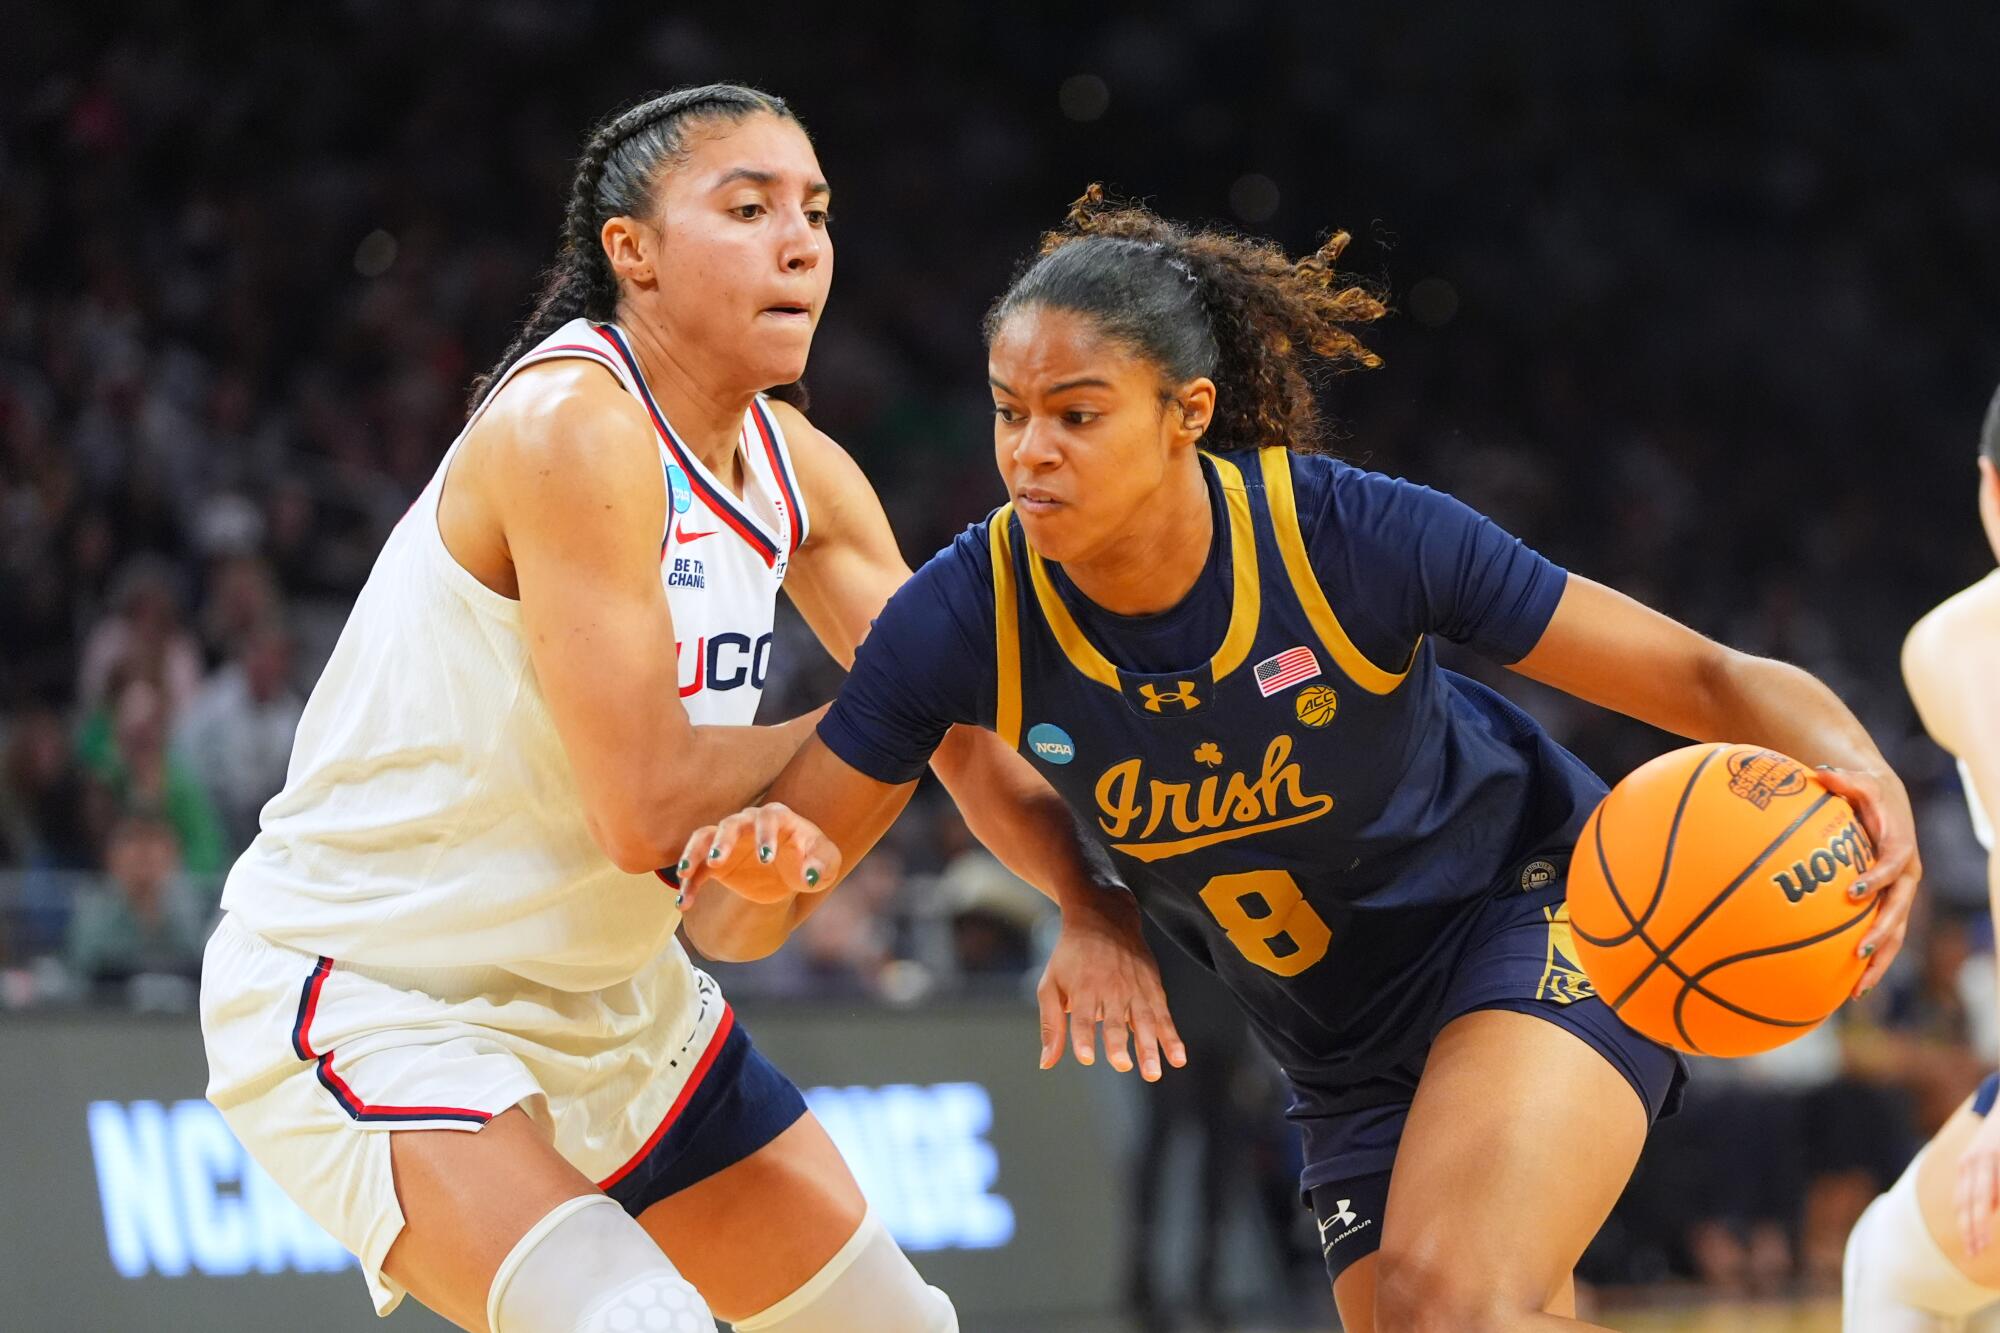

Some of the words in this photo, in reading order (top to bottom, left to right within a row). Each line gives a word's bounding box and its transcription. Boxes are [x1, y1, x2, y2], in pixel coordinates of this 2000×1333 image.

[674, 558, 690, 572] BE
[694, 560, 704, 574] TH
[668, 572, 705, 589] CHANG
[675, 632, 773, 698] UCO
[1301, 691, 1334, 714] ACC
[1035, 742, 1073, 756] NCAA
[1095, 735, 1333, 848] Irish
[1773, 822, 1872, 903] ilson
[1531, 872, 1548, 882] MD
[1198, 870, 1333, 977] 8
[1334, 1219, 1372, 1244] ARMOUR
